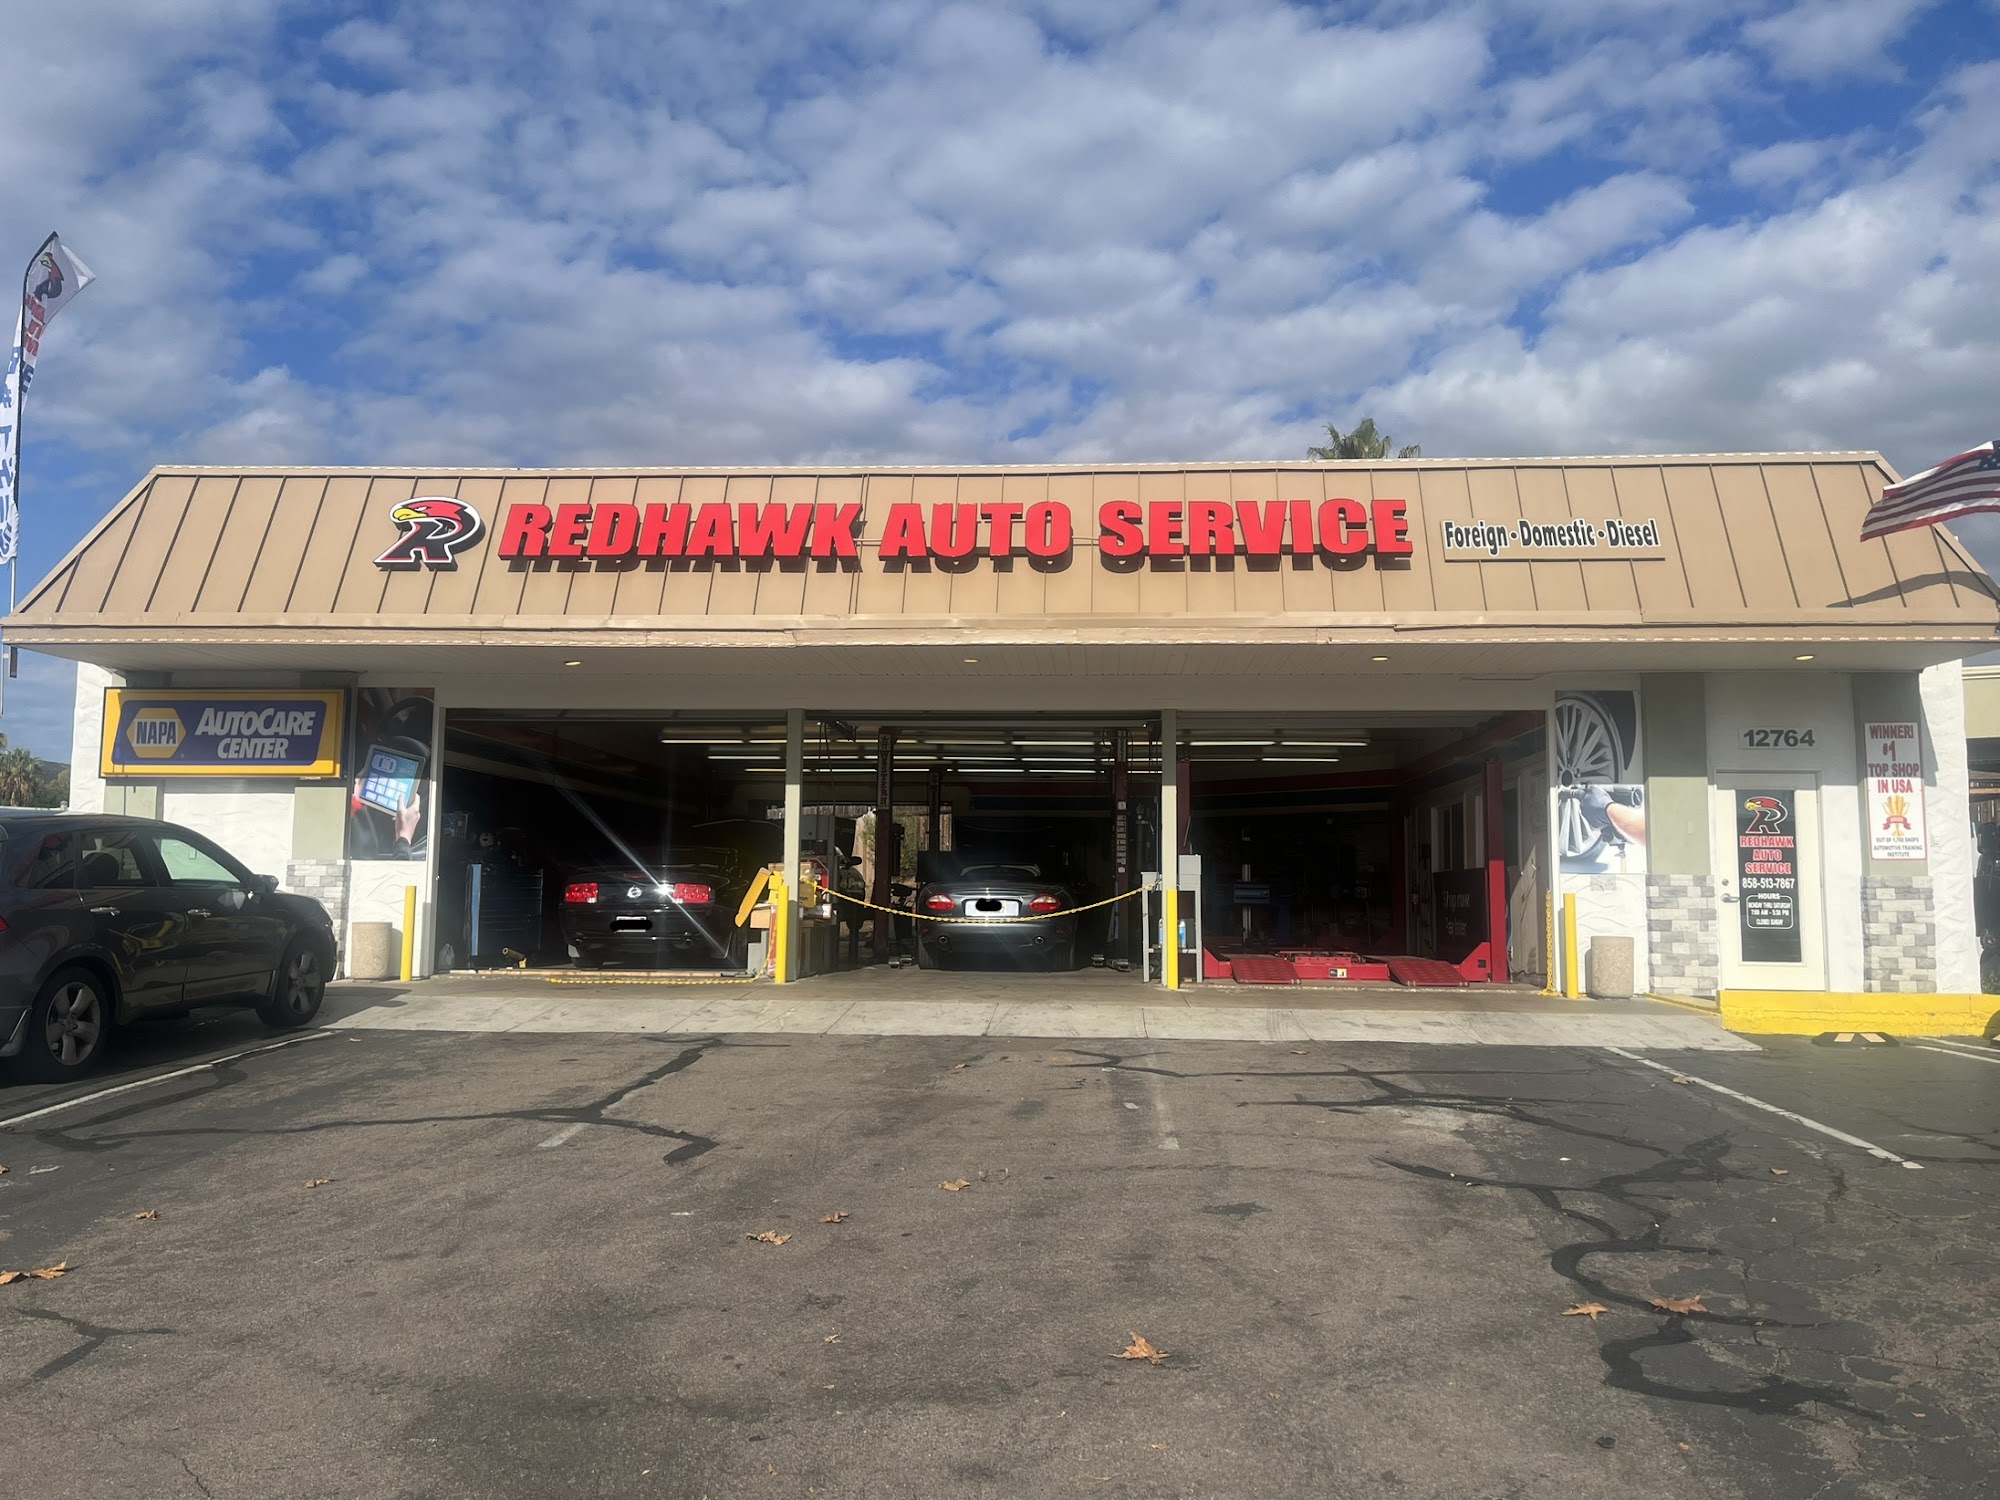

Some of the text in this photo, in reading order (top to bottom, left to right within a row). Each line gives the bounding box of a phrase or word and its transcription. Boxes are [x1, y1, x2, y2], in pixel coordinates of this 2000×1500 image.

[499, 498, 1413, 560] REDHAWK AUTO SERVICE
[1443, 518, 1661, 555] Foreign Domestic Diesel
[136, 721, 177, 745] NAPA
[1743, 729, 1816, 747] 12764
[1869, 724, 1914, 739] WINNER!
[217, 737, 289, 759] CENTER
[1882, 740, 1896, 761] #1
[1868, 763, 1920, 777] TOP SHOP
[1877, 779, 1913, 793] IN USA
[1740, 835, 1794, 848] REDHAWK
[1753, 849, 1782, 861] AUTO
[1745, 862, 1792, 874] SERVICE
[1742, 877, 1795, 889] 858-513-7867
